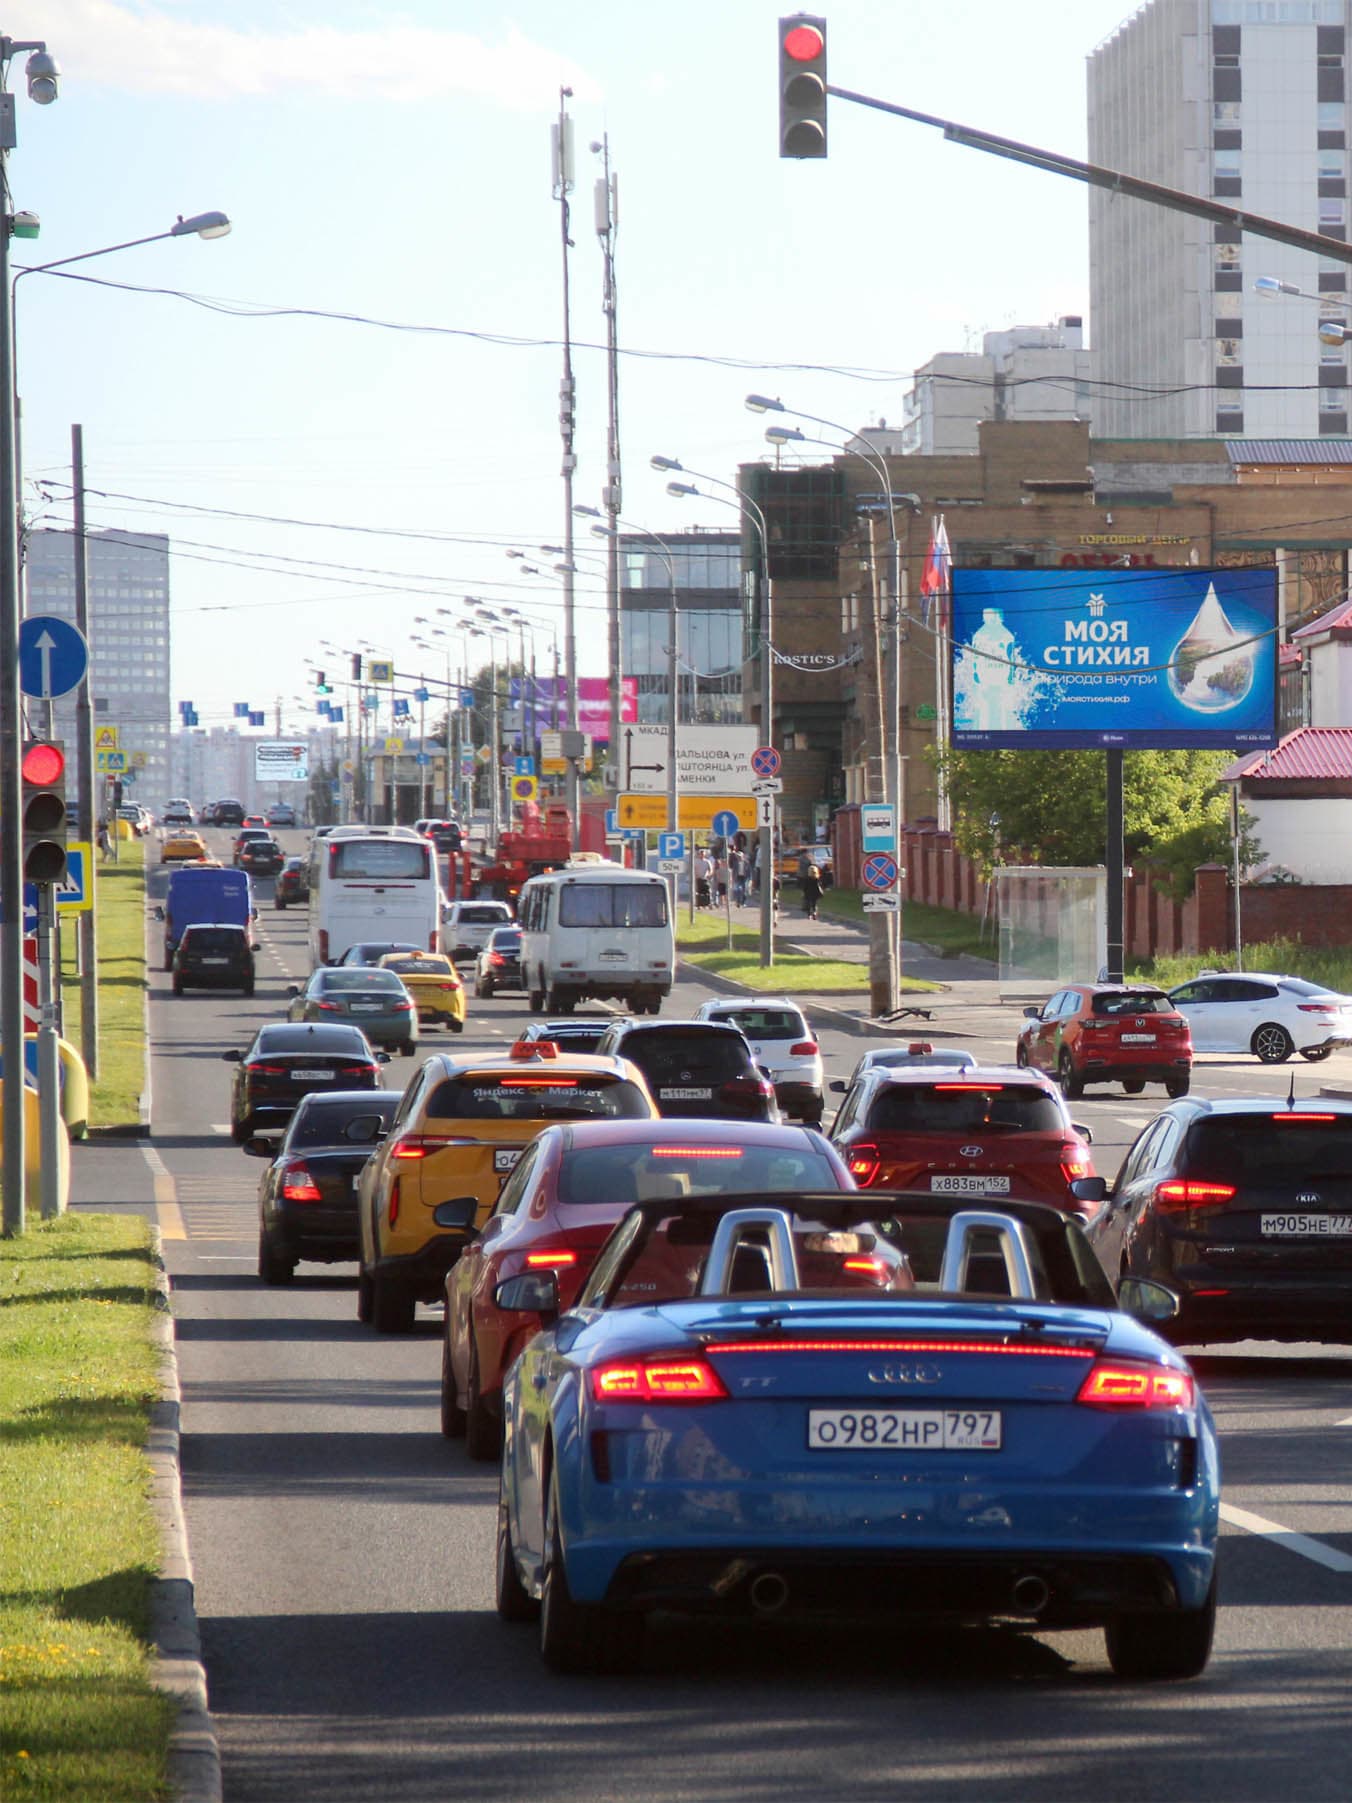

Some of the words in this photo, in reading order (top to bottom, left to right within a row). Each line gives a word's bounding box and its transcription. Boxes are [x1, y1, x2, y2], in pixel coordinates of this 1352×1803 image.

[1064, 620, 1129, 642] МОЯ
[1043, 645, 1150, 666] СТИХИЯ
[1105, 674, 1158, 686] внутри
[638, 726, 670, 737] МКАД
[473, 1086, 526, 1097] Яндекс
[548, 1086, 602, 1097] Маркет
[1299, 1194, 1317, 1203] KIA
[946, 1413, 993, 1436] 797
